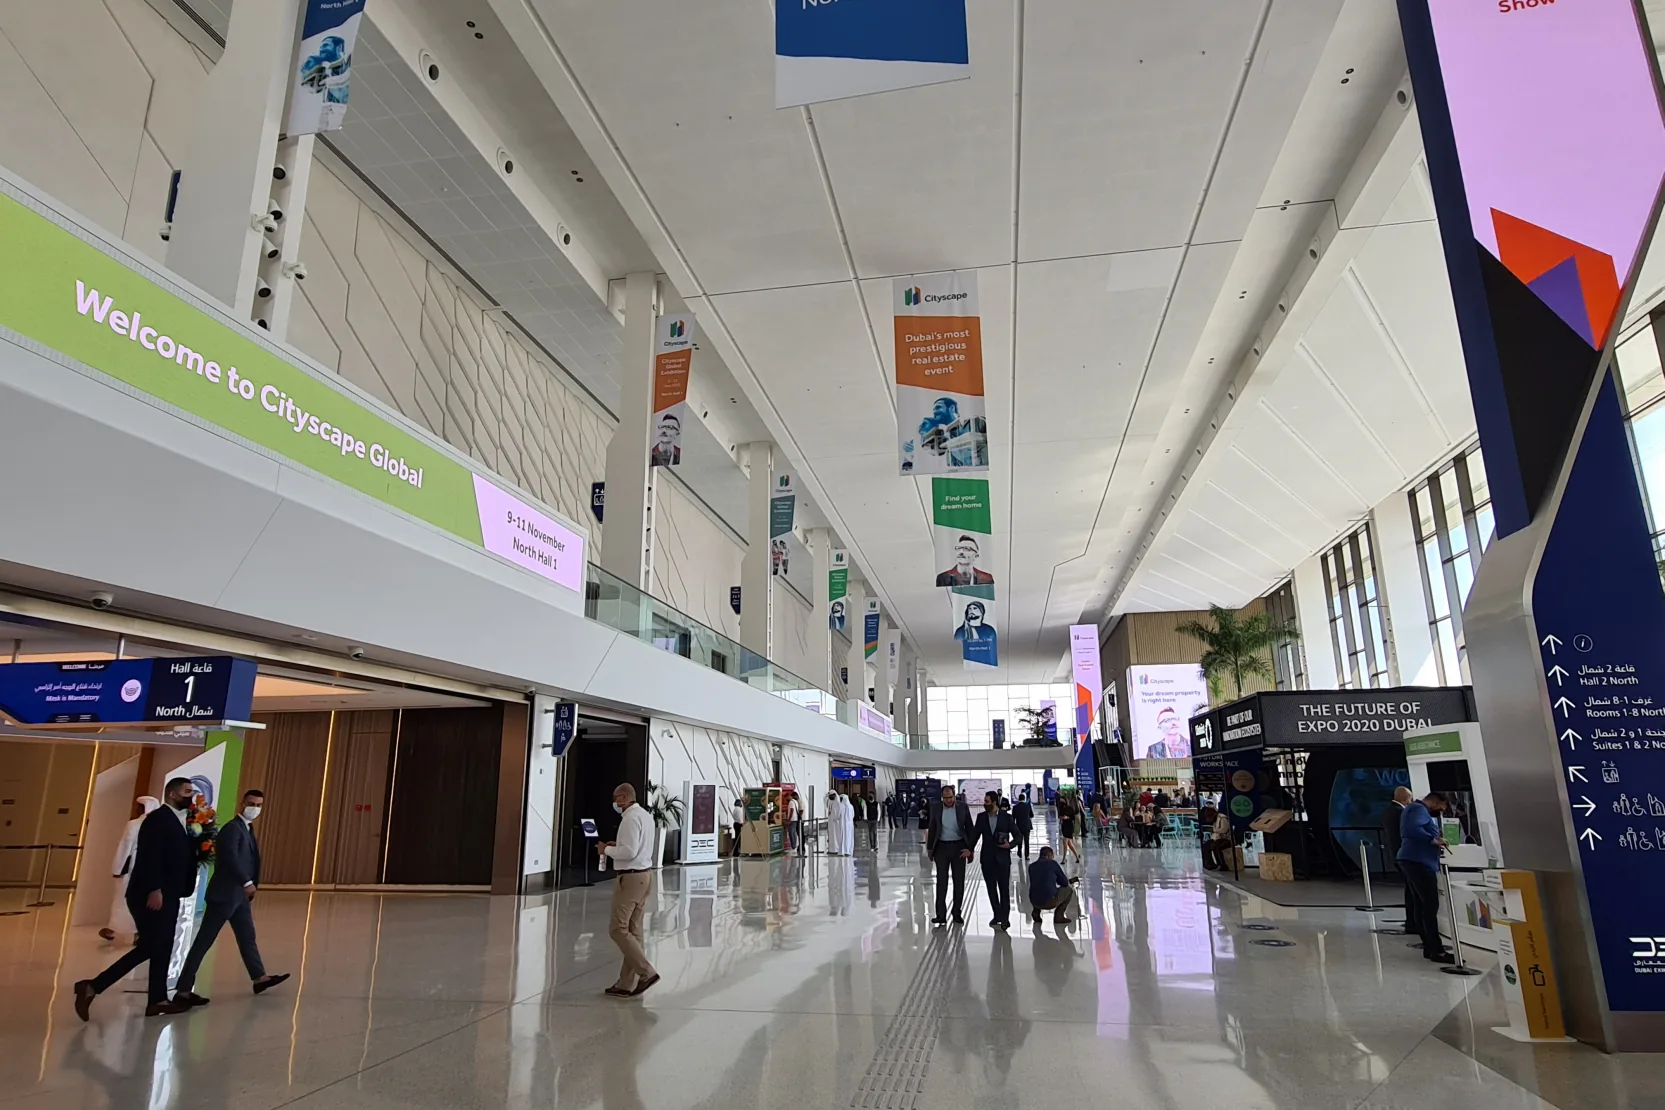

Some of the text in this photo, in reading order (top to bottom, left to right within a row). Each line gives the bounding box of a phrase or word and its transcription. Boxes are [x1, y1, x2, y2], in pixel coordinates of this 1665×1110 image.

[924, 292, 968, 303] Cityscape
[905, 329, 970, 342] Dubai's most
[909, 342, 967, 355] prestigious
[912, 354, 966, 365] real estate
[924, 365, 953, 376] event
[76, 279, 423, 488] Welcome to Cityscape Global
[507, 511, 565, 553] 9-11 November
[513, 536, 557, 570] North Hall 1
[170, 661, 191, 674] Hall
[192, 662, 213, 673] قاعة
[1577, 664, 1636, 676] قاعة 2 شمال
[1580, 675, 1639, 686] Hall 2 North
[184, 675, 195, 703] 1
[1584, 696, 1611, 707] شمال
[1631, 696, 1654, 706] غرف
[155, 705, 185, 717] North
[186, 705, 214, 718] شمال
[1300, 702, 1421, 717] THE FUTURE OF
[1586, 709, 1621, 718] Rooms
[1623, 708, 1640, 717] 1-8
[1298, 718, 1433, 733] EXPO 2020 DUBAI
[1590, 729, 1618, 740] شمال
[1619, 728, 1626, 737] 2
[1628, 730, 1635, 739] و
[1637, 728, 1643, 737] 1
[1592, 740, 1665, 750] Suites 1 & 2 No
